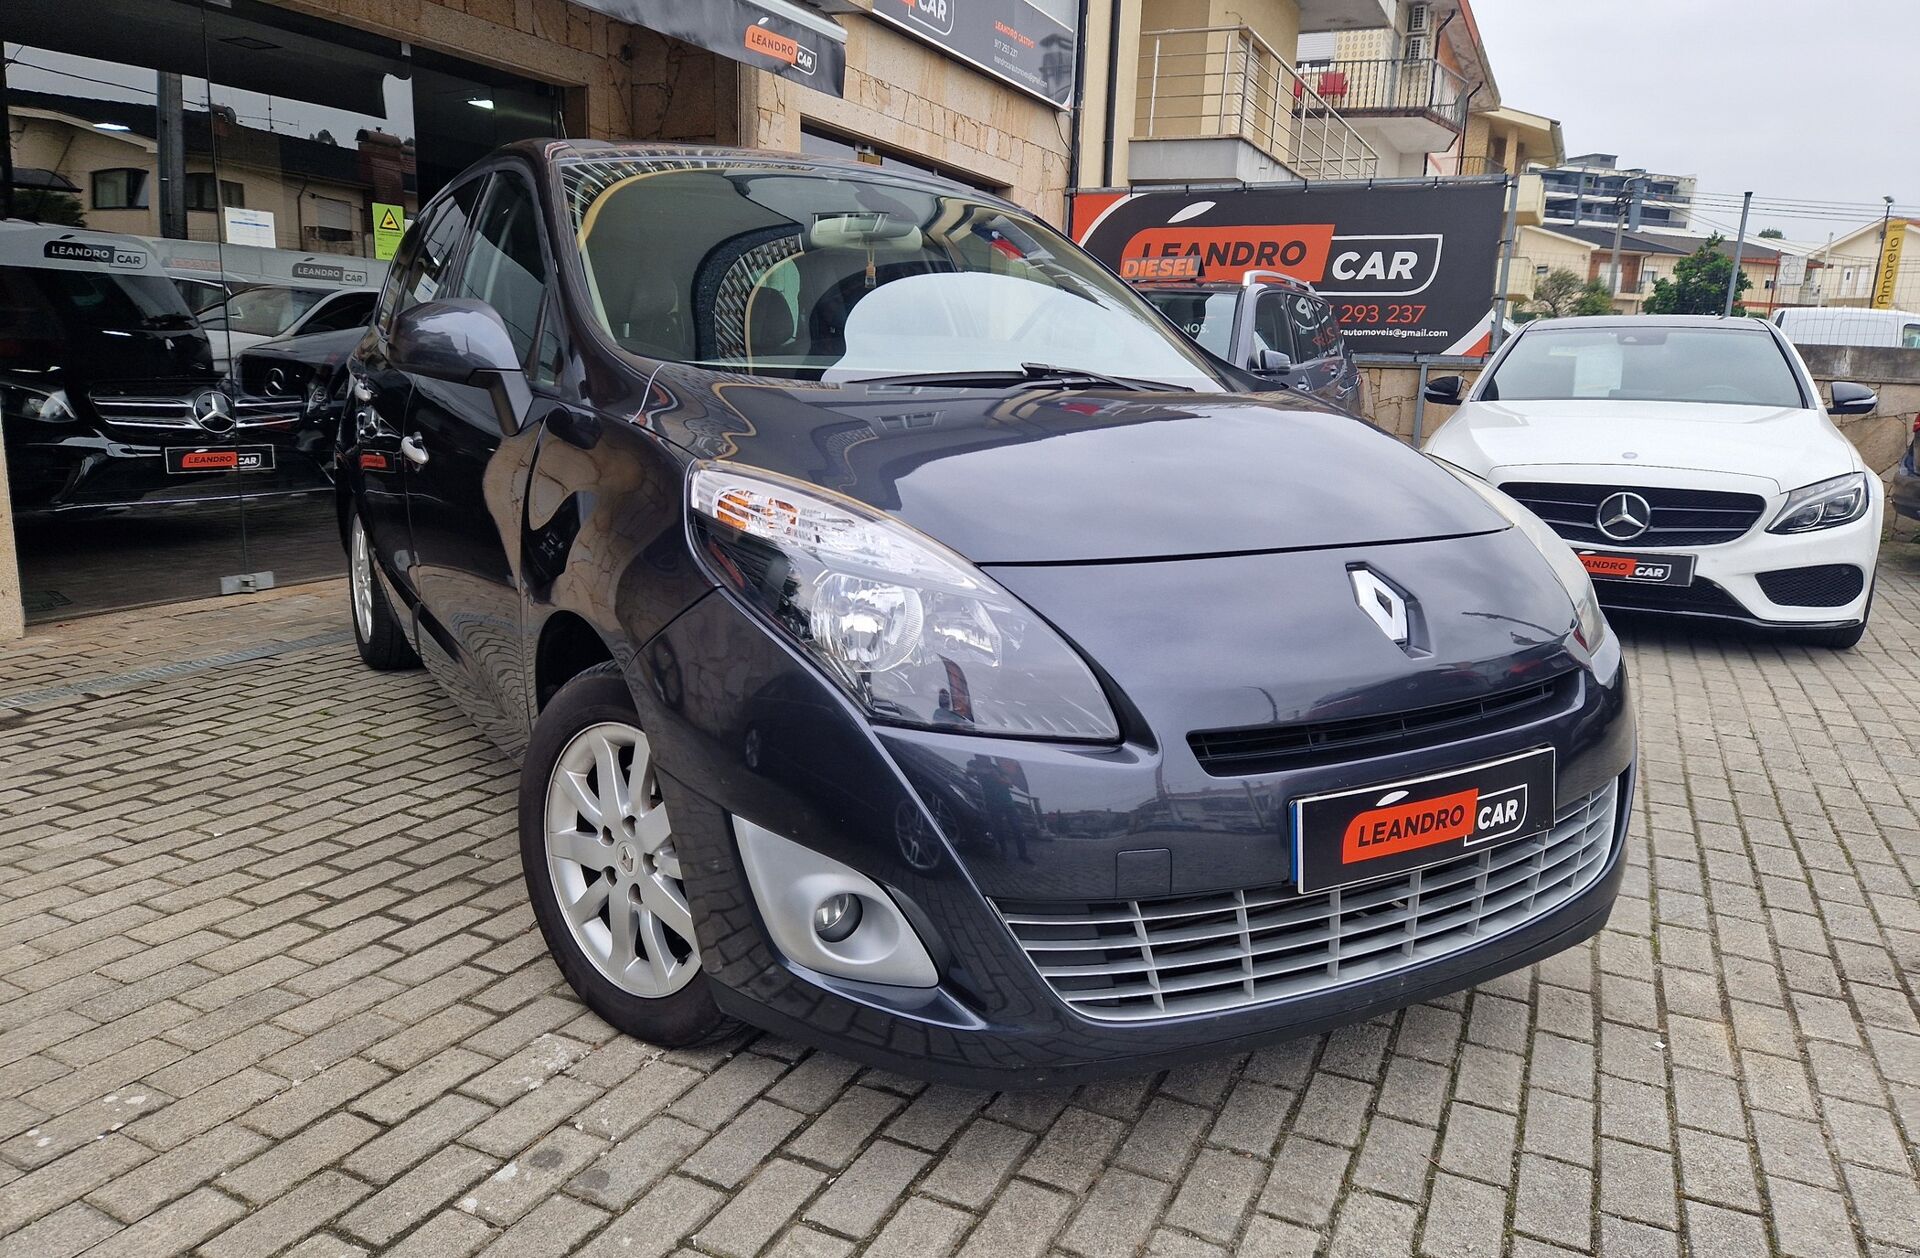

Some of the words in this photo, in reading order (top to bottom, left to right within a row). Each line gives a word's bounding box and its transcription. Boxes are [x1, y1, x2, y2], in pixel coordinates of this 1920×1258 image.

[751, 32, 794, 56] LEANDRO
[797, 51, 813, 68] CAR
[51, 245, 110, 259] LEANDRO
[116, 254, 141, 265] CAR
[297, 267, 340, 278] LEANDRO
[345, 273, 363, 283] CAR
[1122, 257, 1198, 278] DIESEL
[1332, 251, 1418, 281] CAR
[1876, 237, 1900, 305] Amarela
[1340, 304, 1379, 323] 293
[1386, 304, 1427, 323] 237
[1340, 327, 1448, 338] rautomoveis@gmail.com
[188, 455, 232, 464] LEANDRO
[238, 456, 257, 465] CAR
[1583, 559, 1628, 571] ANDRO
[1634, 567, 1665, 577] CAR
[1357, 804, 1465, 848] LEANDRO
[1477, 799, 1519, 830] CAR
